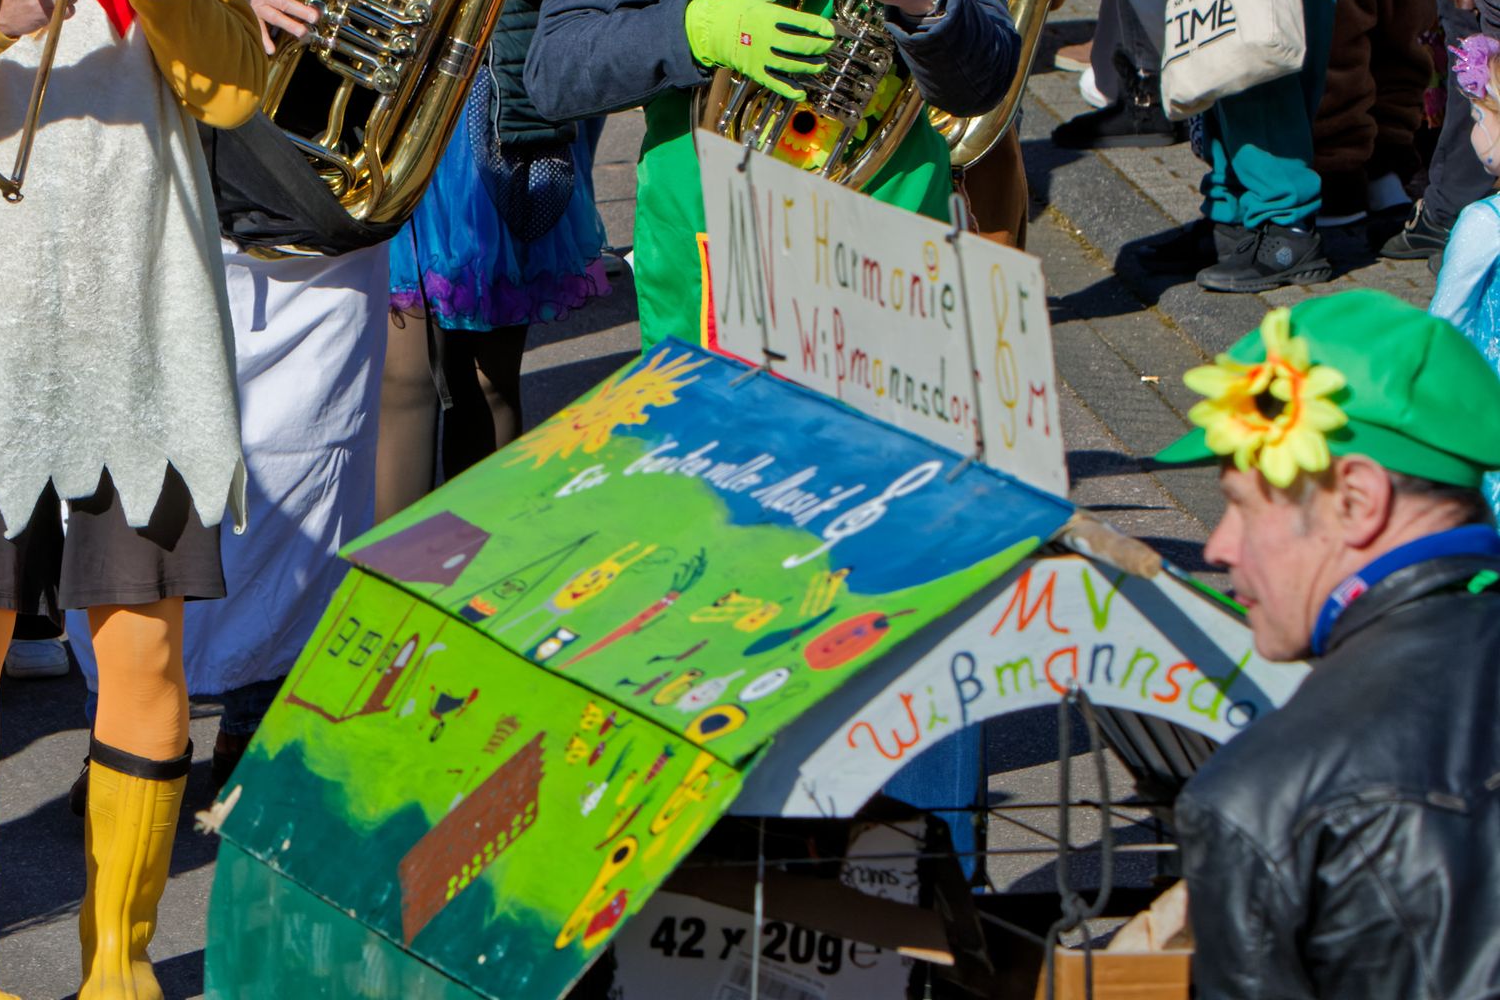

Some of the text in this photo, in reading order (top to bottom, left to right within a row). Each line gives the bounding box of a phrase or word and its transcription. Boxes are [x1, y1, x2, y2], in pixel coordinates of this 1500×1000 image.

[812, 190, 955, 330] Harmonie
[650, 916, 707, 959] 42
[719, 928, 747, 960] x
[761, 920, 843, 976] 20g
